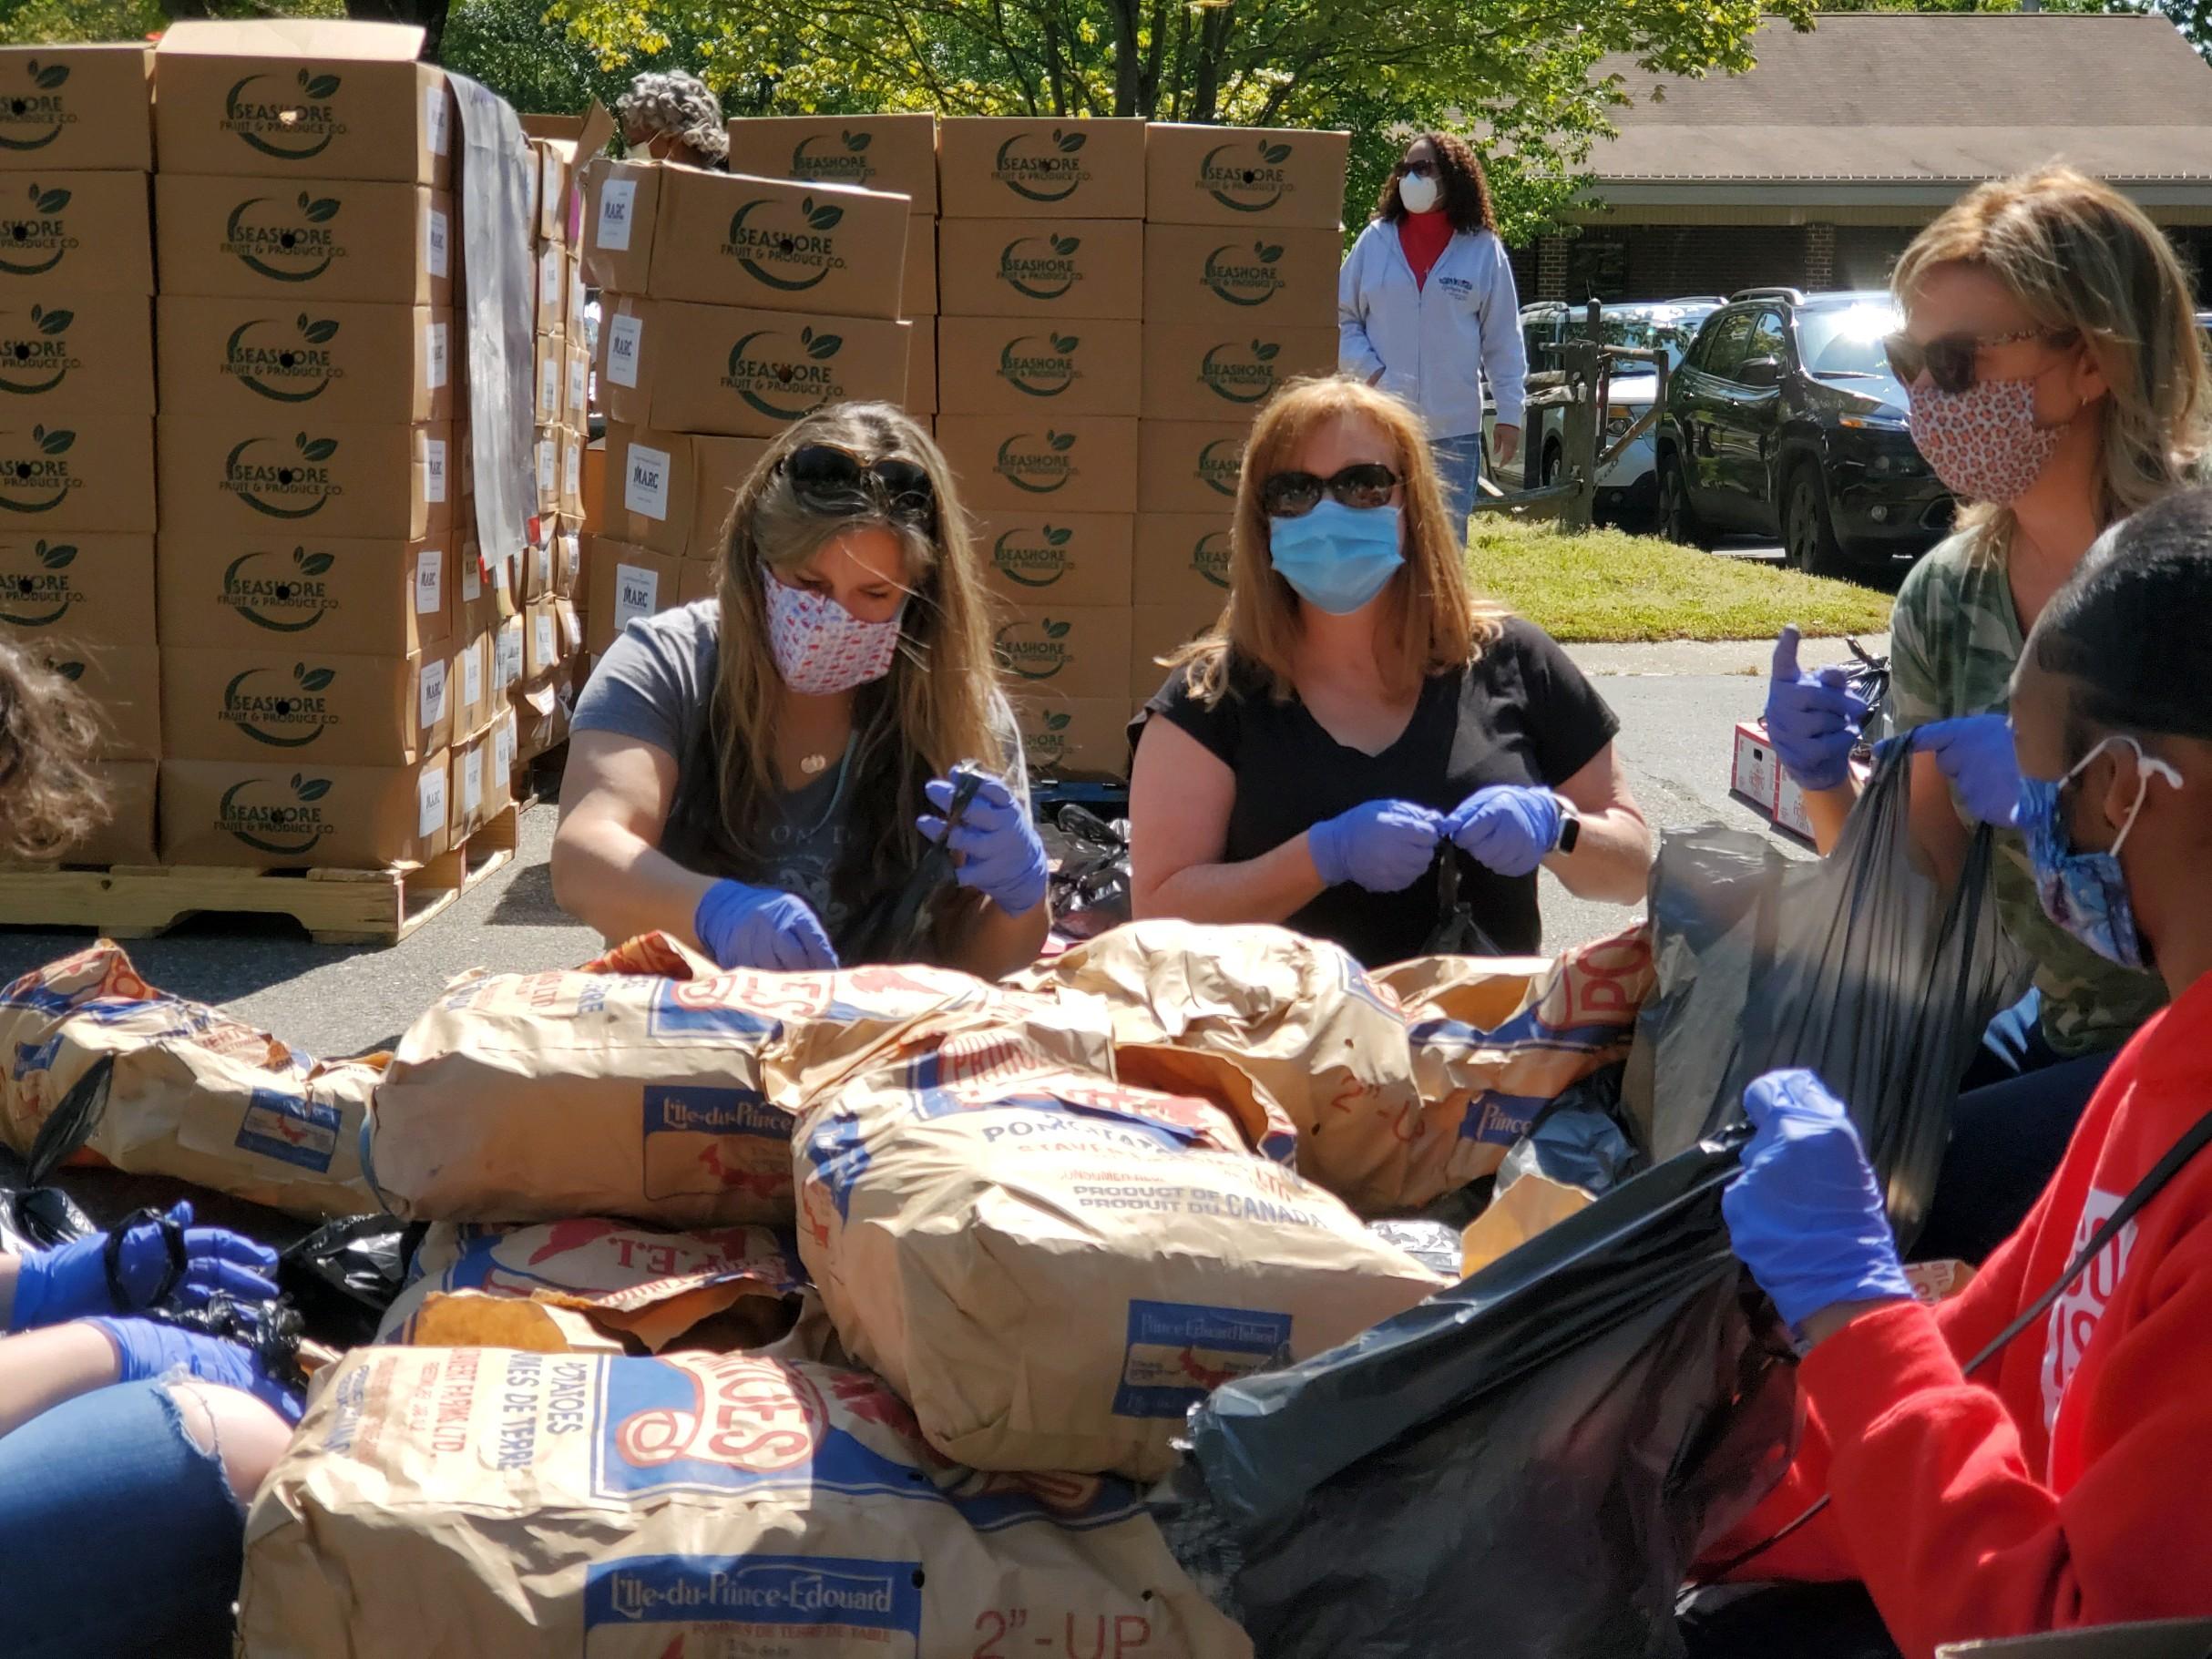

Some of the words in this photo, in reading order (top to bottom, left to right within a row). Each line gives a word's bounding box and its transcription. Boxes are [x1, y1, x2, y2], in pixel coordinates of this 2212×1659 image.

[0, 96, 62, 112] SORE
[233, 104, 333, 122] SEASORE
[219, 120, 250, 131] FRUIT
[268, 122, 323, 134] PRODUCE
[1209, 168, 1284, 181] SEASORE
[1, 220, 64, 236] SORE
[235, 227, 332, 245] SEASORE
[220, 243, 251, 254] FRUIT
[268, 245, 323, 257] PRODUCE
[721, 244, 752, 259] FRUIT
[757, 249, 763, 260] &
[768, 250, 823, 266] PRODUCE
[826, 257, 848, 270] CO.
[1006, 260, 1074, 271] SEASHORE
[3, 341, 66, 357] SORE
[235, 348, 330, 366] SEASORE
[220, 364, 250, 374] FRUIT
[267, 365, 323, 377] PRODUCE
[1005, 357, 1071, 370] SEASHORE
[720, 376, 750, 389] FRUIT
[756, 381, 763, 391] &
[767, 381, 822, 395] PRODUCE
[825, 385, 846, 397] CO.
[0, 460, 68, 476] SORE
[1004, 456, 1069, 467] SEASHORE
[1203, 459, 1241, 470] SEASH
[234, 466, 328, 483] SEASORE
[633, 466, 660, 489] MARC
[219, 481, 248, 492] FRUIT
[253, 483, 261, 492] &
[266, 484, 322, 495] PRODUCE
[1198, 552, 1232, 563] SEAS
[0, 575, 68, 591] ASORE
[231, 579, 324, 597] SEASORE
[5, 592, 61, 602] PRODUCE
[217, 595, 246, 605] FRUIT
[251, 597, 259, 606] &
[263, 597, 317, 609] PRODUCE
[622, 584, 648, 608] MARC
[232, 696, 325, 712] SEASORE
[219, 712, 247, 721] FRUIT
[251, 712, 259, 722] &
[263, 712, 317, 724] PRODUCE
[213, 822, 241, 831] FRUIT
[259, 823, 312, 834] PRODUCE
[1072, 1185, 1183, 1199] PRODUCT
[1190, 1187, 1220, 1201] OF
[1079, 1198, 1179, 1212] PRODUIT
[1187, 1201, 1220, 1215] DU
[1225, 1193, 1327, 1228] CANADA
[503, 1393, 538, 1413] DE
[496, 1416, 538, 1471] TERRE
